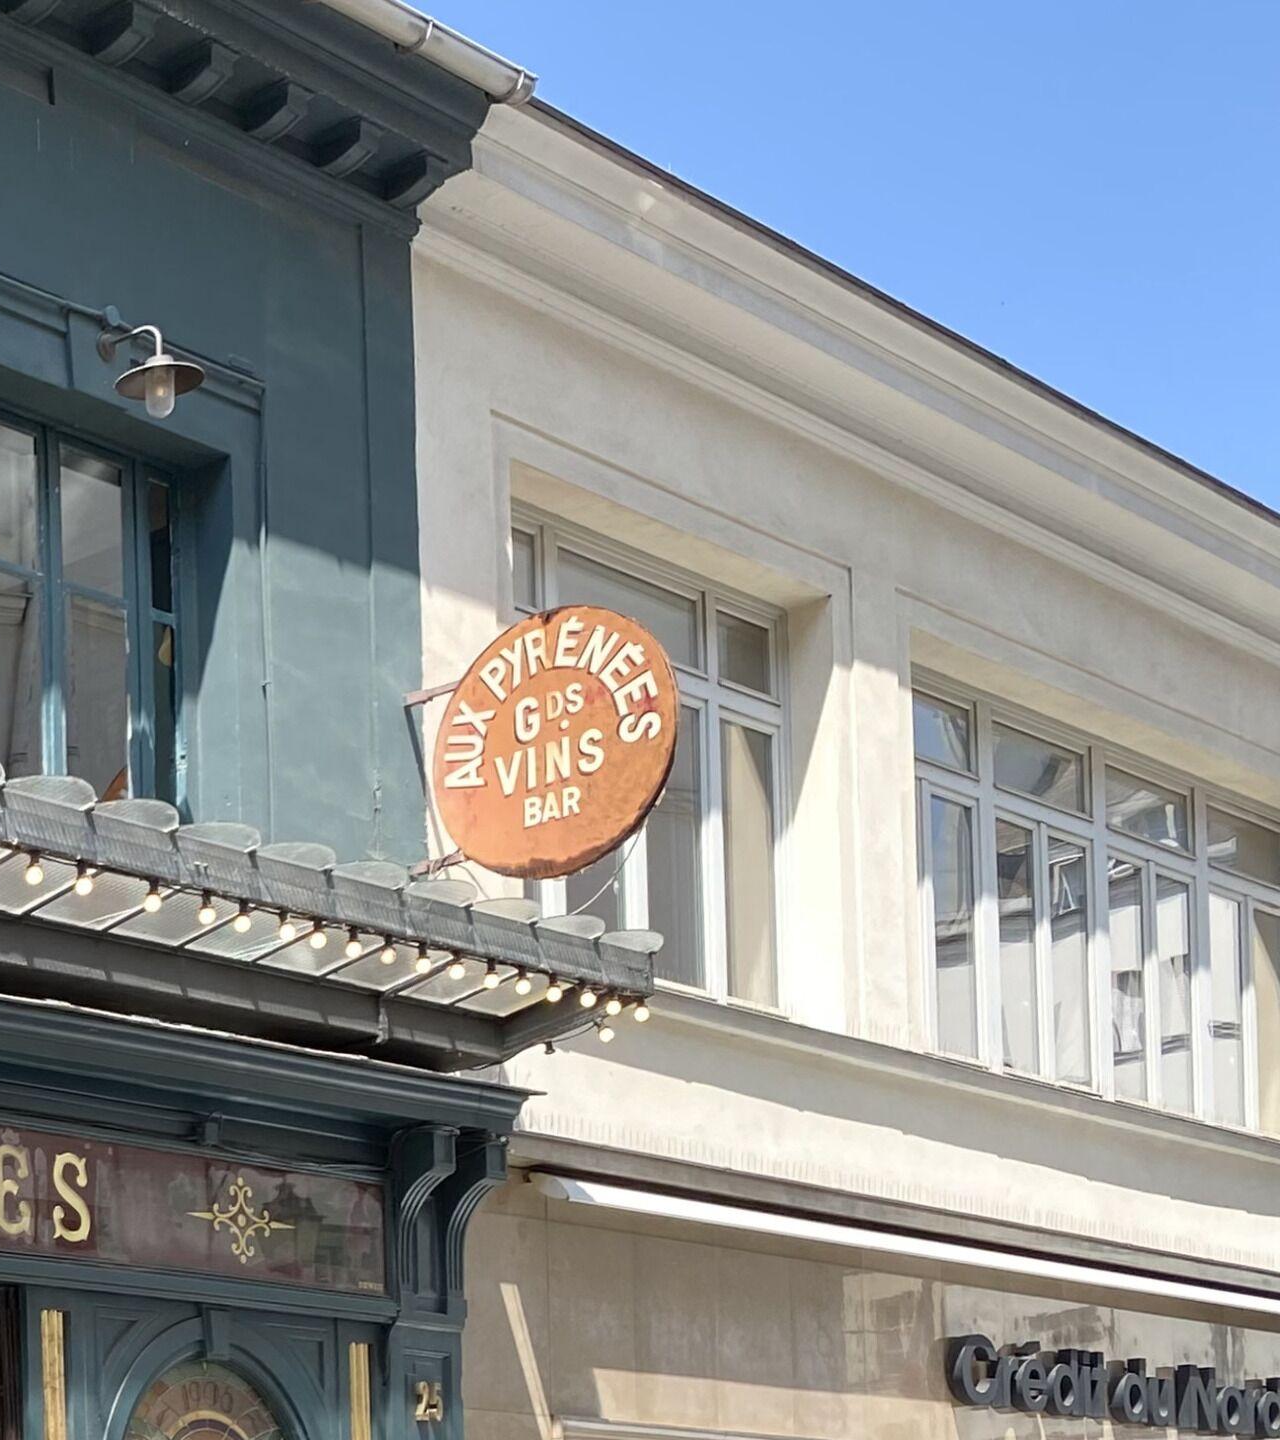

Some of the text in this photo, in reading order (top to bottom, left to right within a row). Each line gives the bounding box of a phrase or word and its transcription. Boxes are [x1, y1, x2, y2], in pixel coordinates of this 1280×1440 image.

[444, 616, 662, 788] AUX PYRÉNÉES
[494, 728, 605, 797] VINS
[523, 786, 581, 828] BAR
[415, 1381, 443, 1421] 25
[945, 1334, 1109, 1418] Crédit
[1110, 1358, 1177, 1426] du
